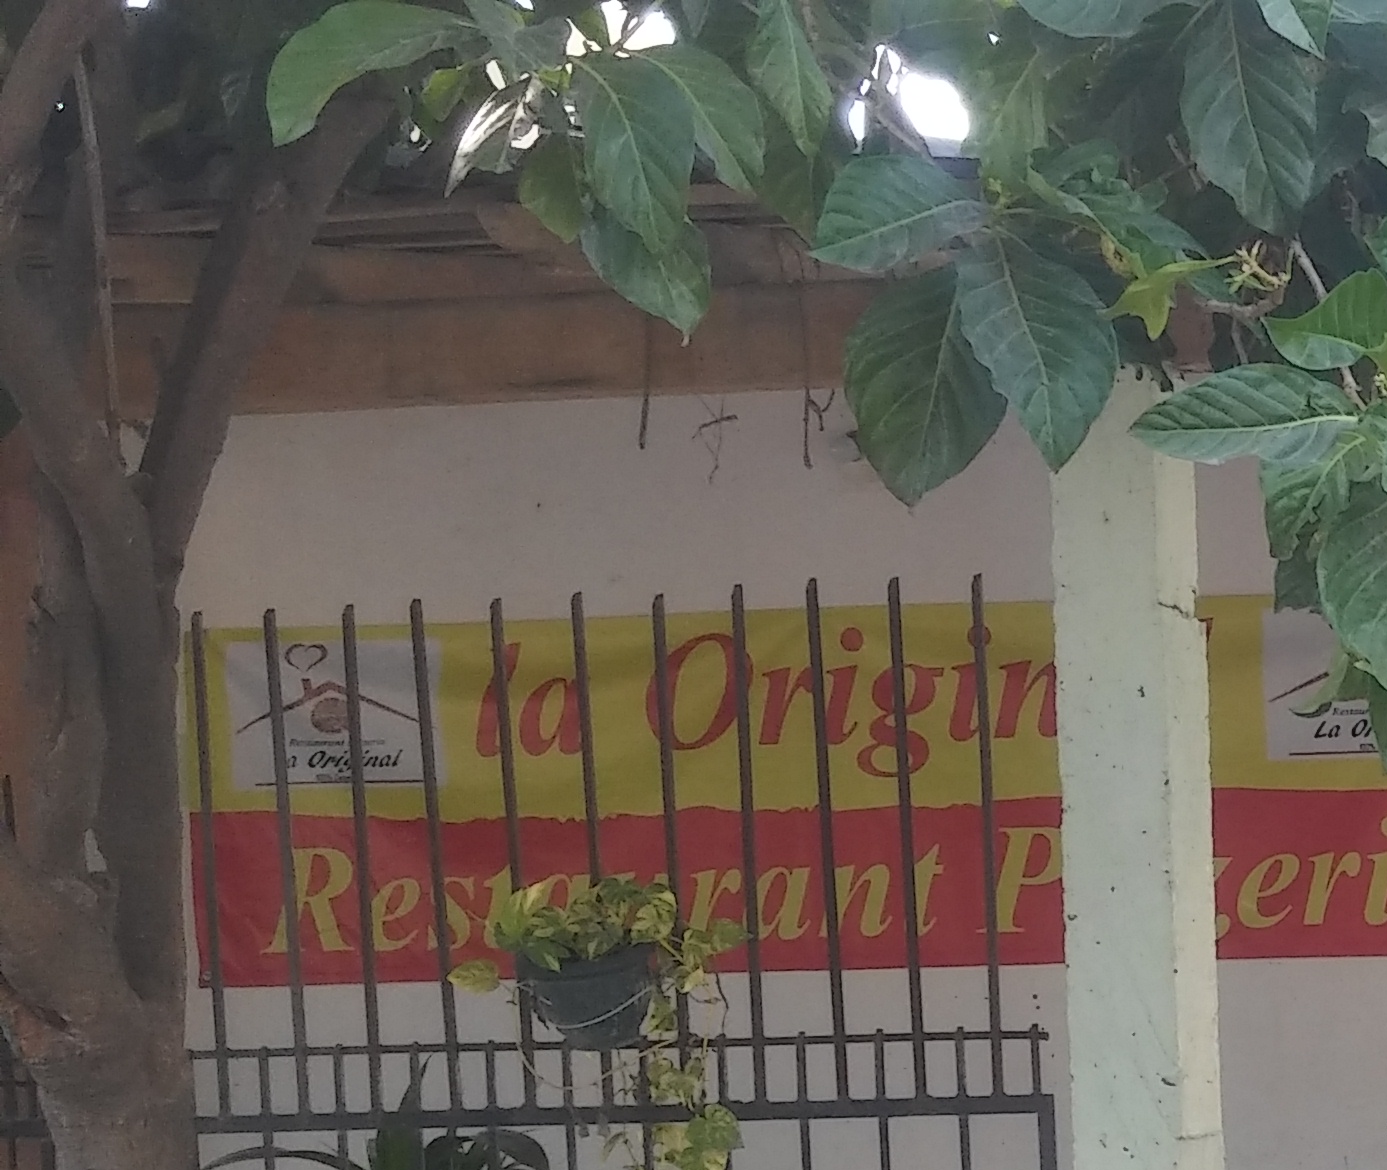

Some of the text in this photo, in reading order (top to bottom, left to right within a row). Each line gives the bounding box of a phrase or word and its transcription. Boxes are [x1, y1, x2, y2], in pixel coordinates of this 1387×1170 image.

[475, 617, 1213, 778] la Origin
[1313, 720, 1341, 739] La
[260, 842, 944, 957] Restrant
